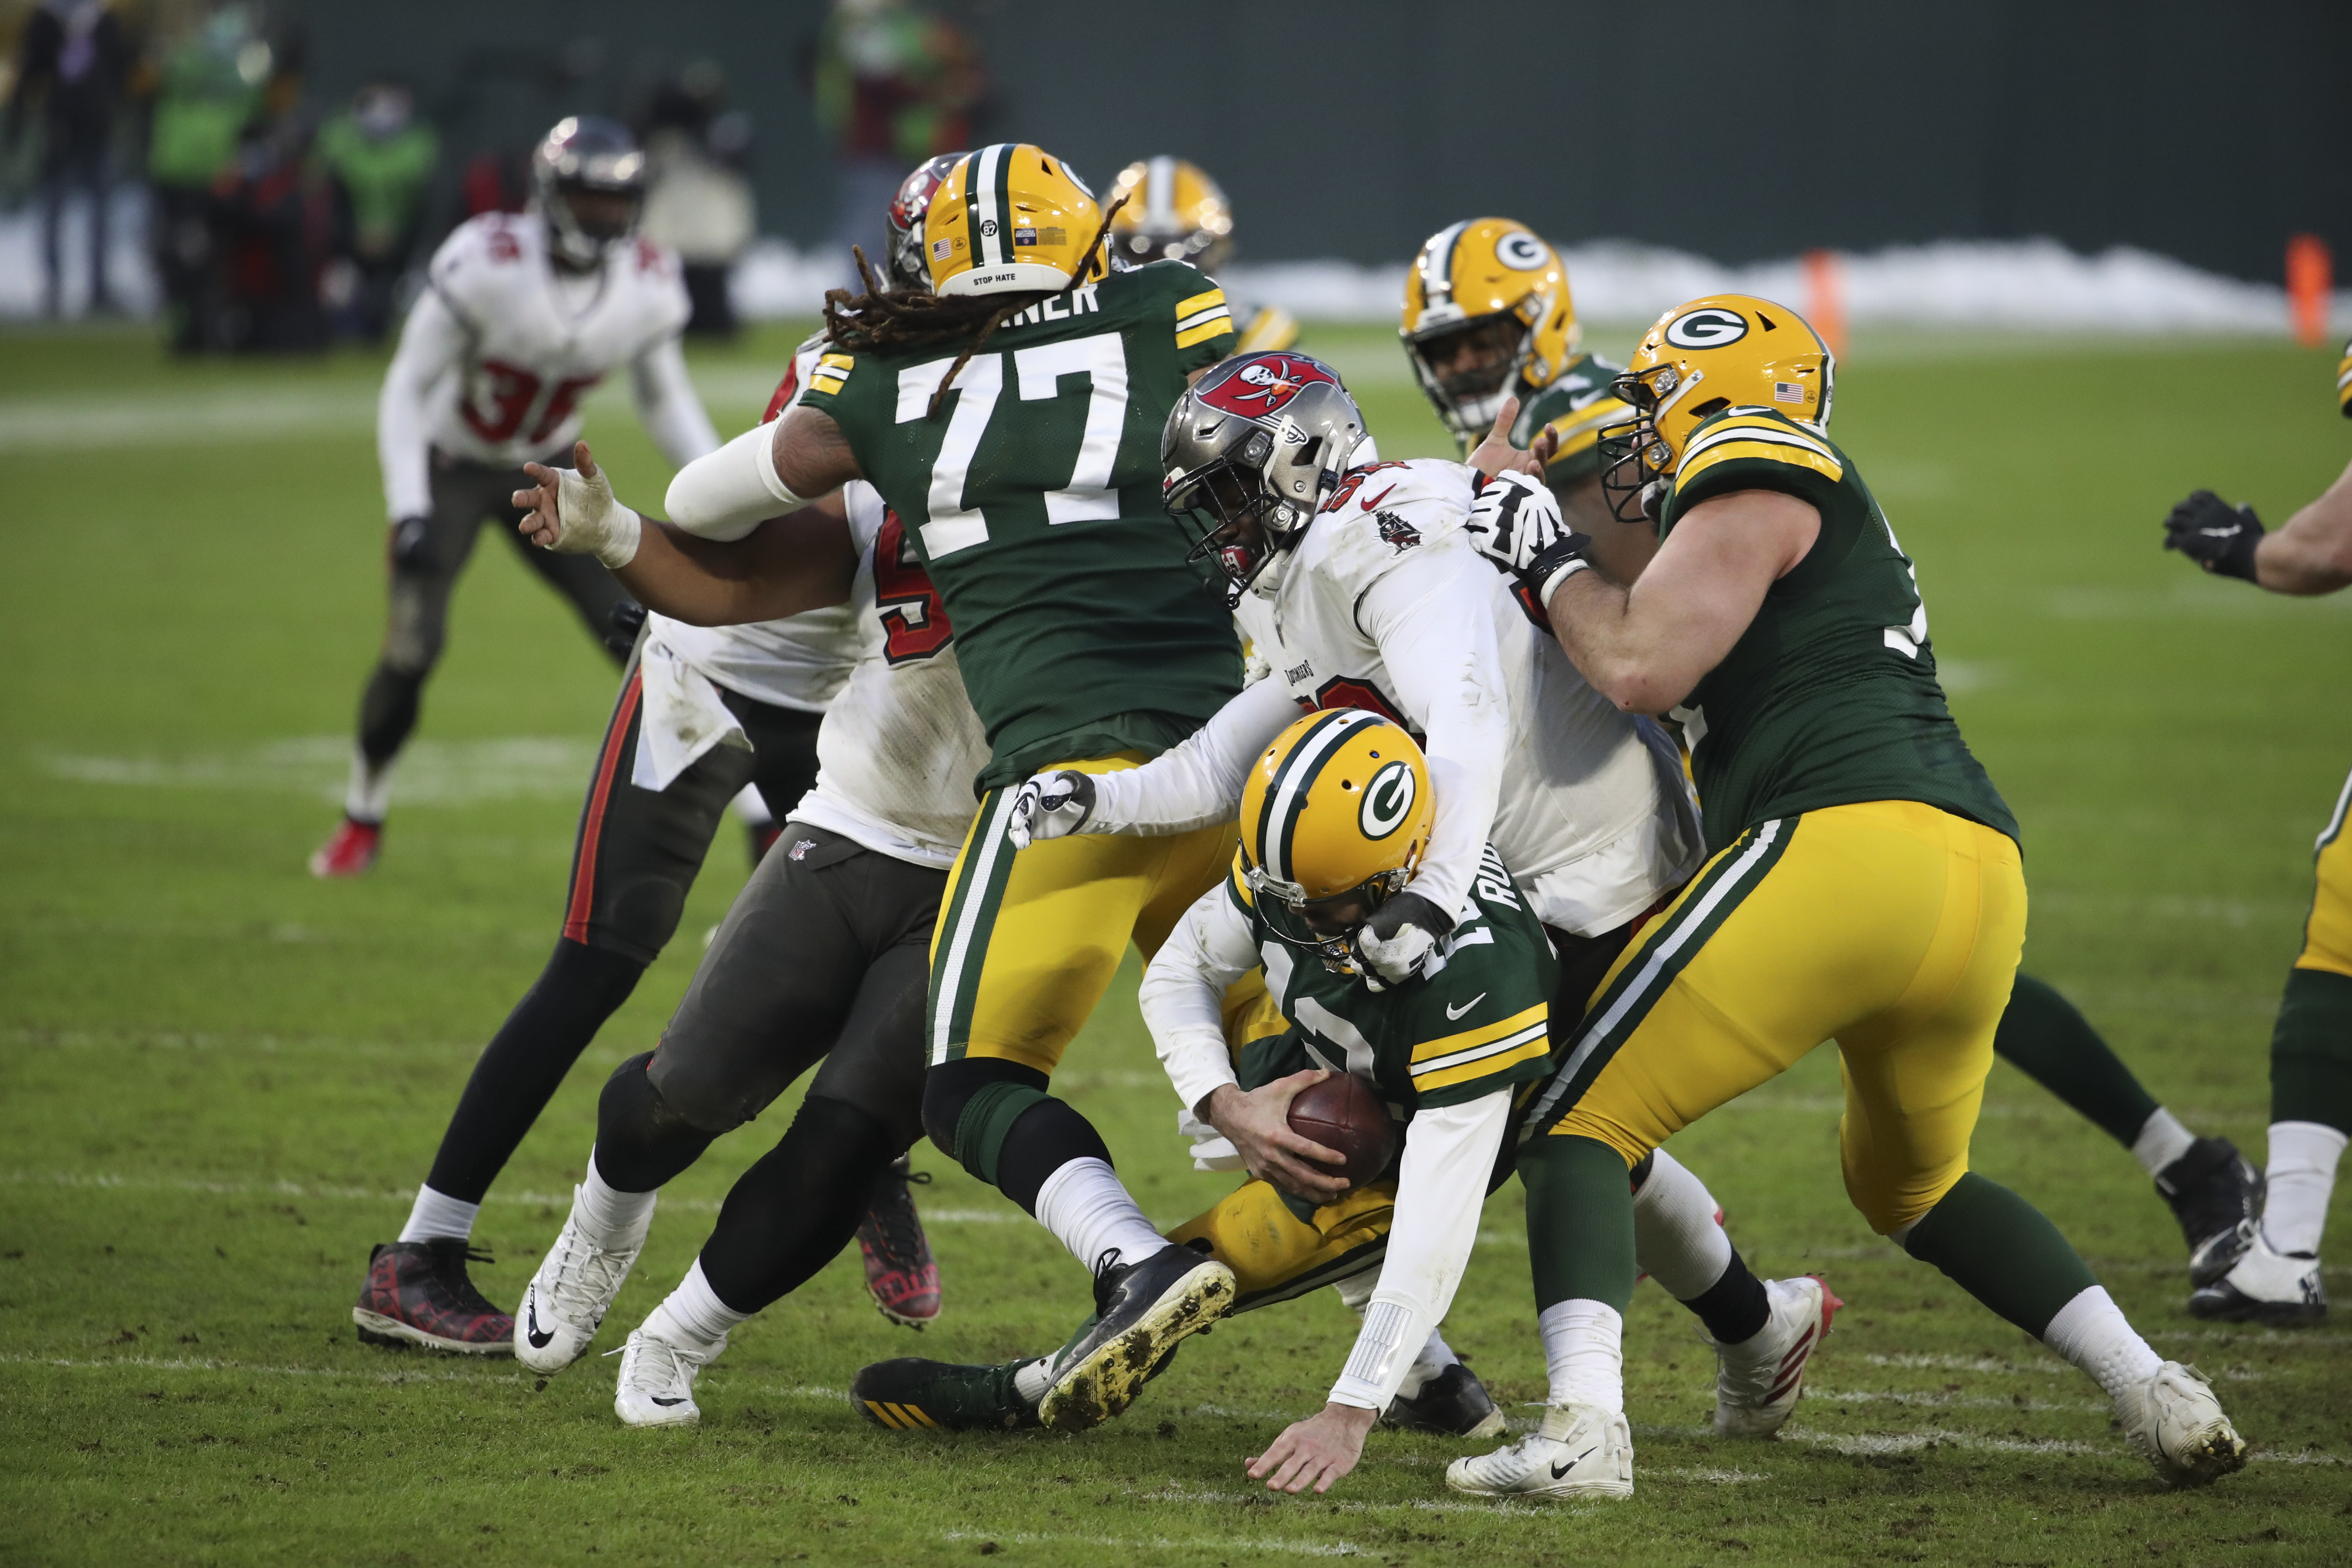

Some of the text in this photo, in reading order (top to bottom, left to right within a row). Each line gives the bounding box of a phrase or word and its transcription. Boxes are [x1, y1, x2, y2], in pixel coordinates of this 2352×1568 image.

[983, 225, 995, 235] 87
[974, 273, 1016, 286] STOP HATE
[1000, 283, 1099, 328] NER
[1665, 308, 1749, 349] G
[895, 329, 1129, 561] 77
[1358, 761, 1415, 841] G
